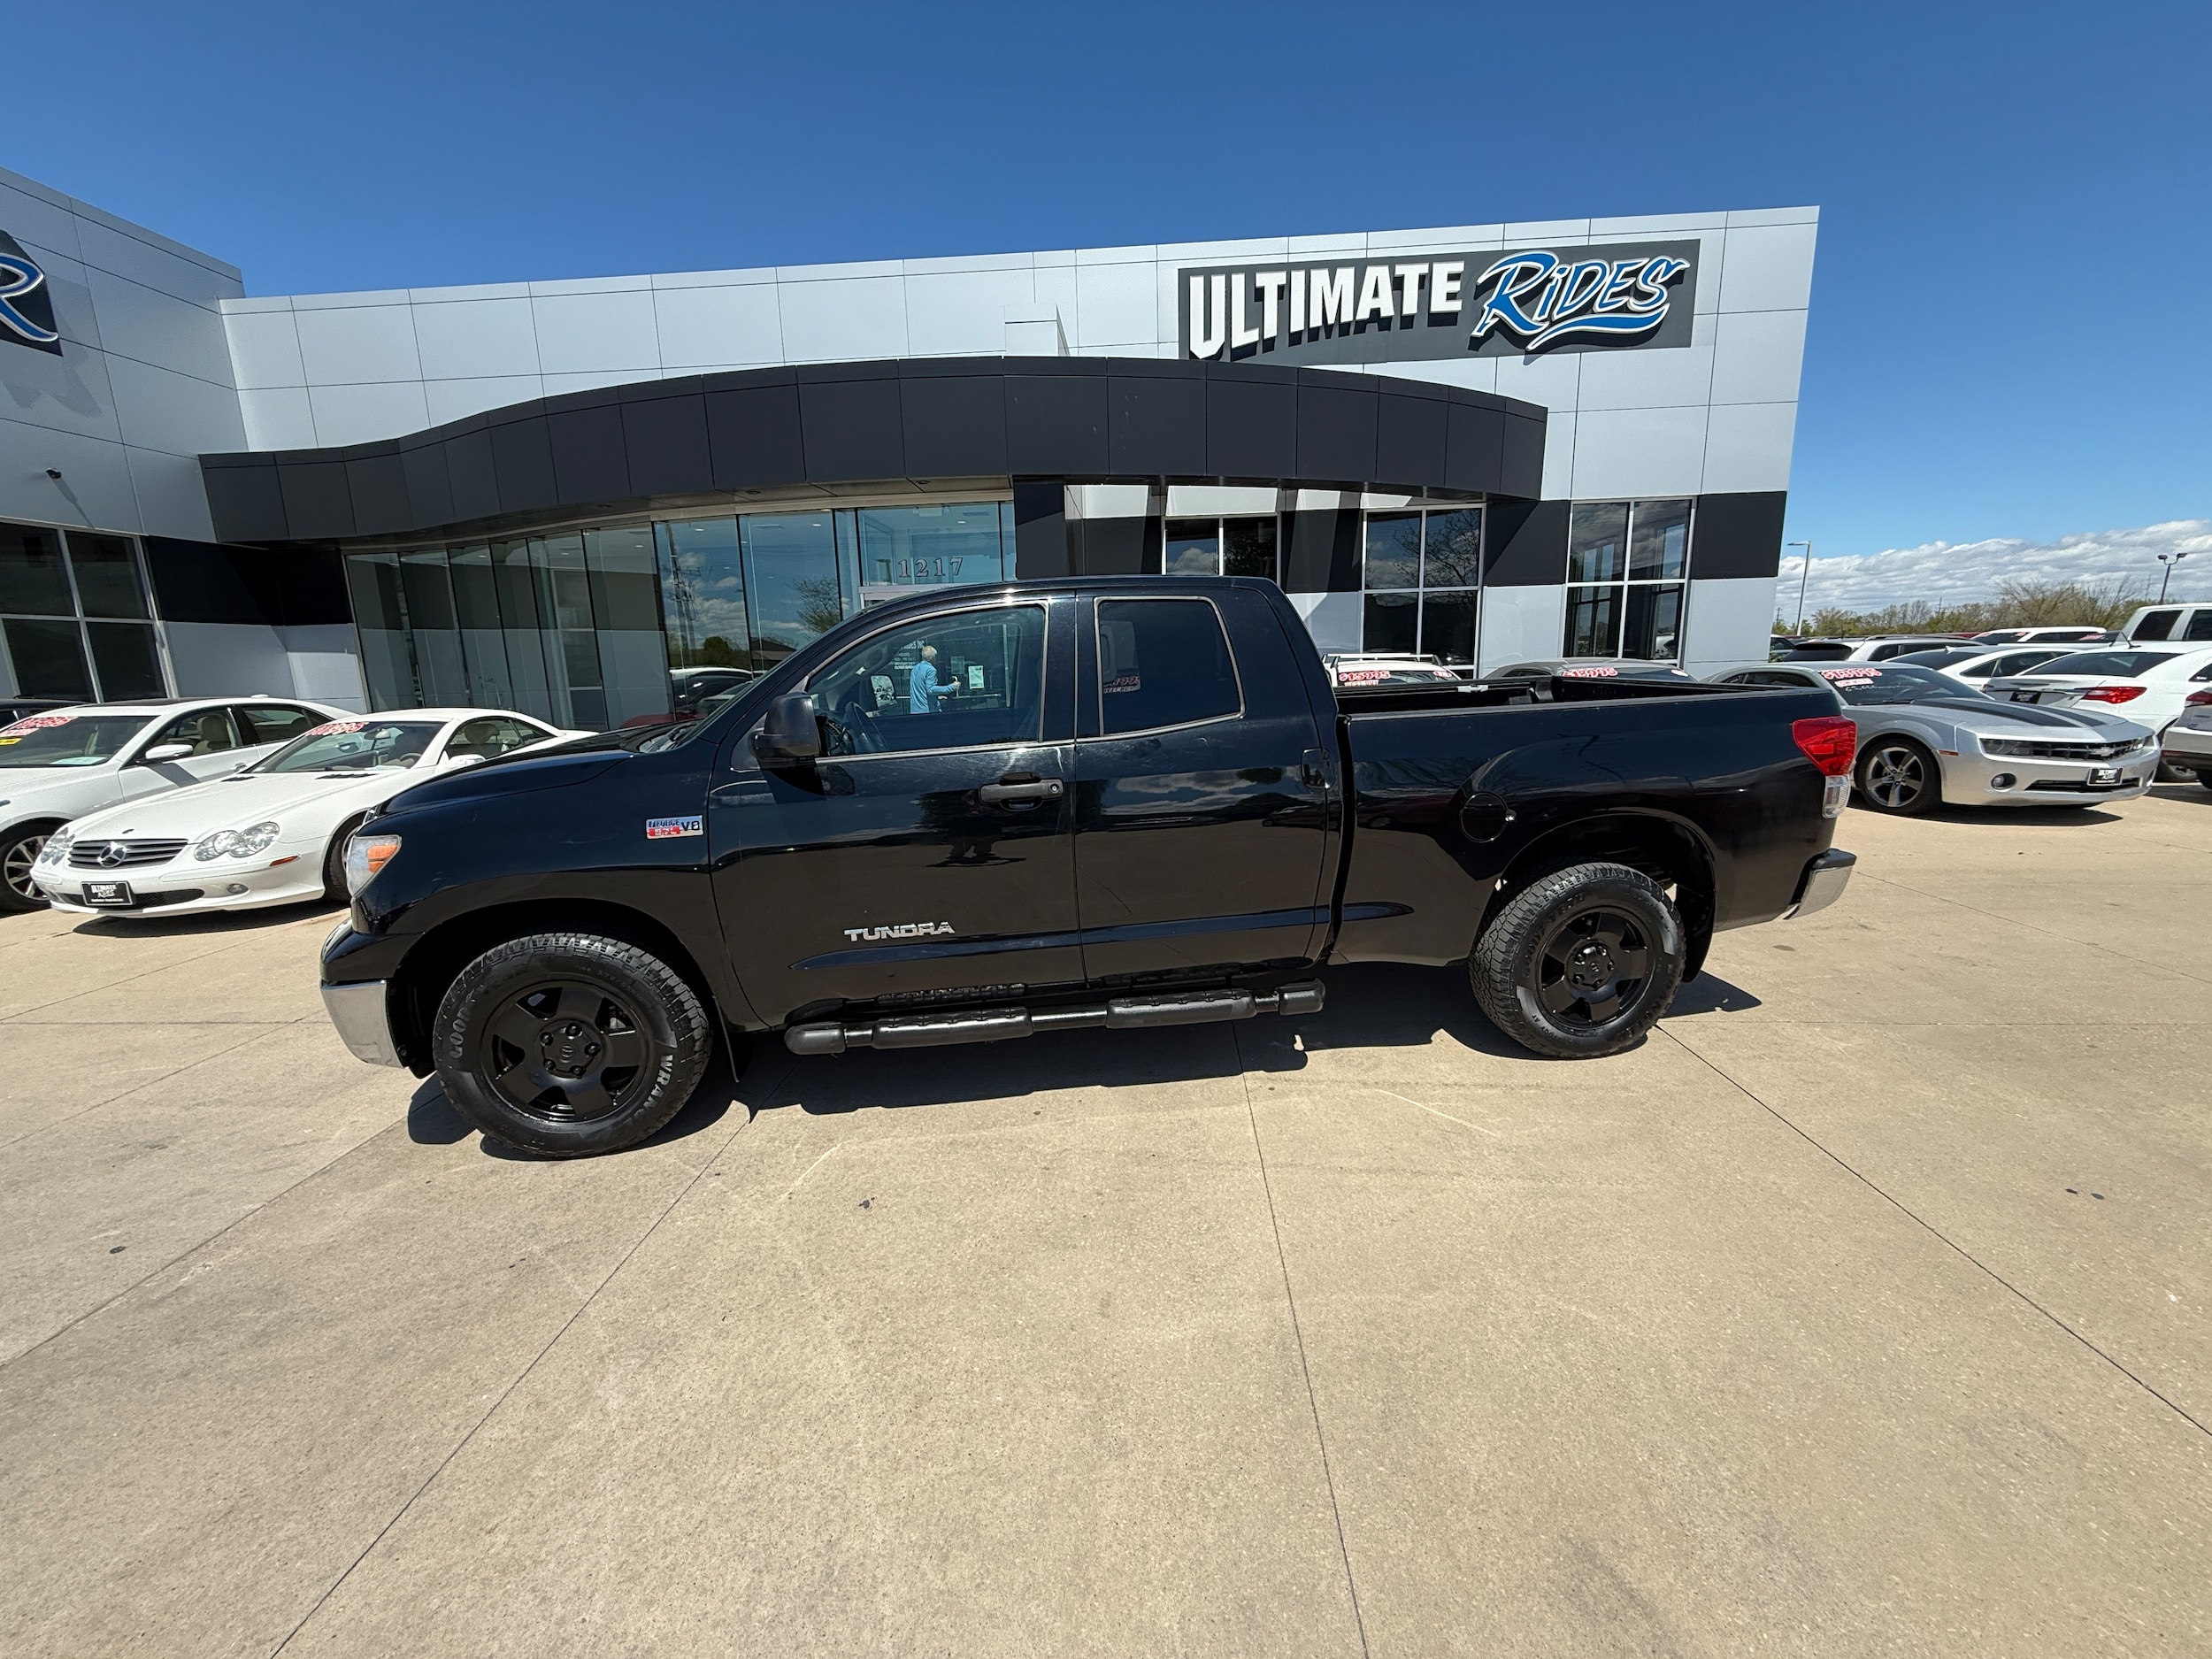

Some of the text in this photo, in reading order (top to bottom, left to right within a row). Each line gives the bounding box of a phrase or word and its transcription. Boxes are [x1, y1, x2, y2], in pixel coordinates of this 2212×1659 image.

[1188, 261, 1465, 360] ULTIMATE
[898, 557, 964, 578] 1217
[681, 820, 701, 832] V8
[843, 921, 956, 942] TUNDRA
